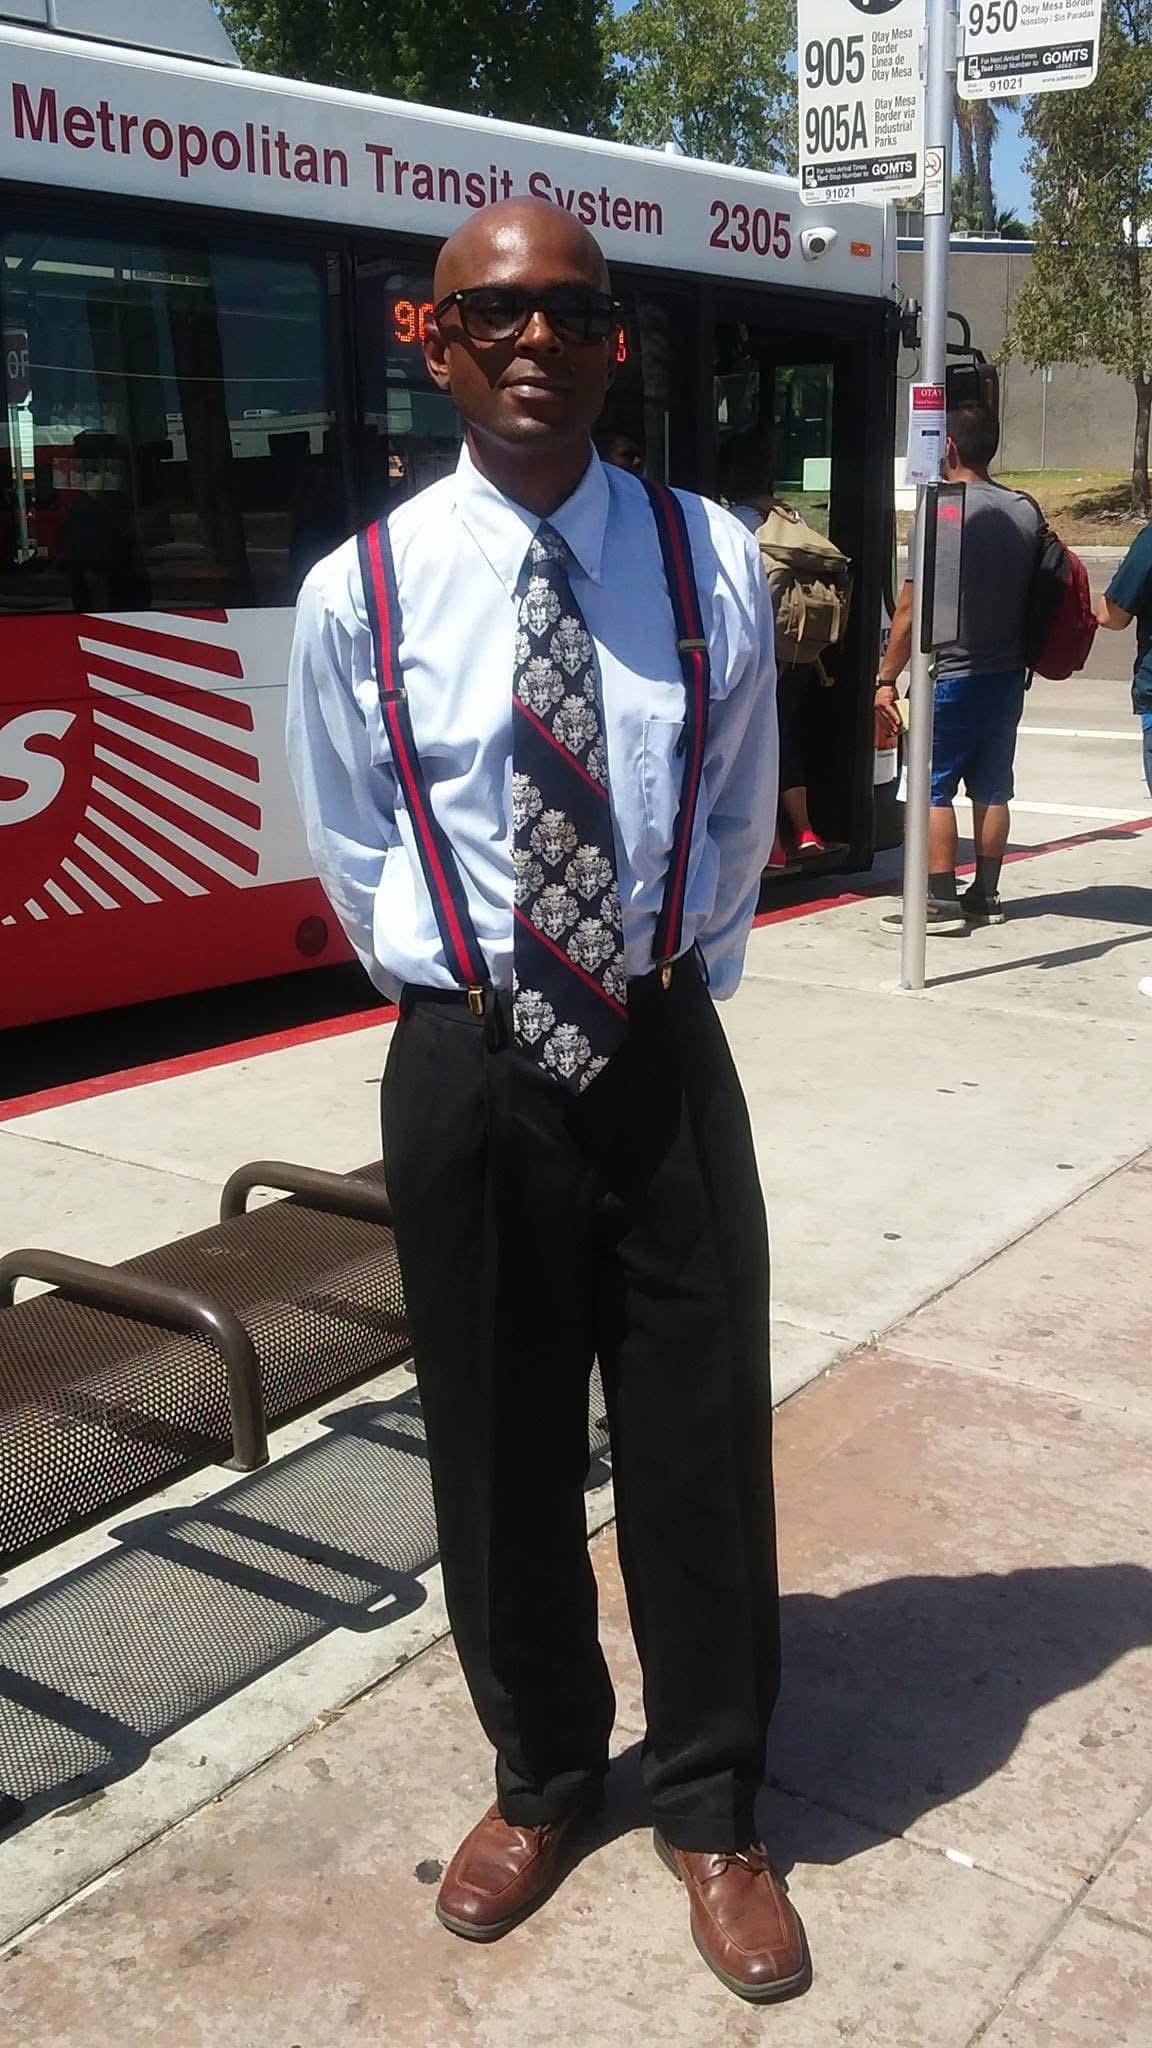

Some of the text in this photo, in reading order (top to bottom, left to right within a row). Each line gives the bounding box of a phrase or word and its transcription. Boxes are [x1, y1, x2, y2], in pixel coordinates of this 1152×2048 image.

[1021, 5, 1040, 14] Otay
[1042, 1, 1063, 11] Mesa
[968, 0, 1018, 36] 950
[1020, 15, 1048, 26] Nonstop
[1067, 9, 1095, 20] Paradas
[872, 28, 913, 43] Otay Mesa
[872, 43, 898, 55] Border
[1042, 48, 1088, 65] GOMTS
[805, 35, 865, 88] 905
[895, 54, 905, 65] de
[872, 67, 912, 81] Otay Mesa
[989, 77, 1023, 92] 91021
[874, 95, 916, 110] Otay Mesa
[874, 108, 915, 122] Border via
[805, 100, 868, 155] 905A
[874, 120, 913, 134] Industrial
[874, 136, 897, 148] Parks
[12, 82, 349, 187] Metropolitan
[365, 143, 514, 208] Transit
[709, 200, 791, 259] 2305
[872, 160, 913, 176] GOMTS
[825, 187, 855, 199] 91021
